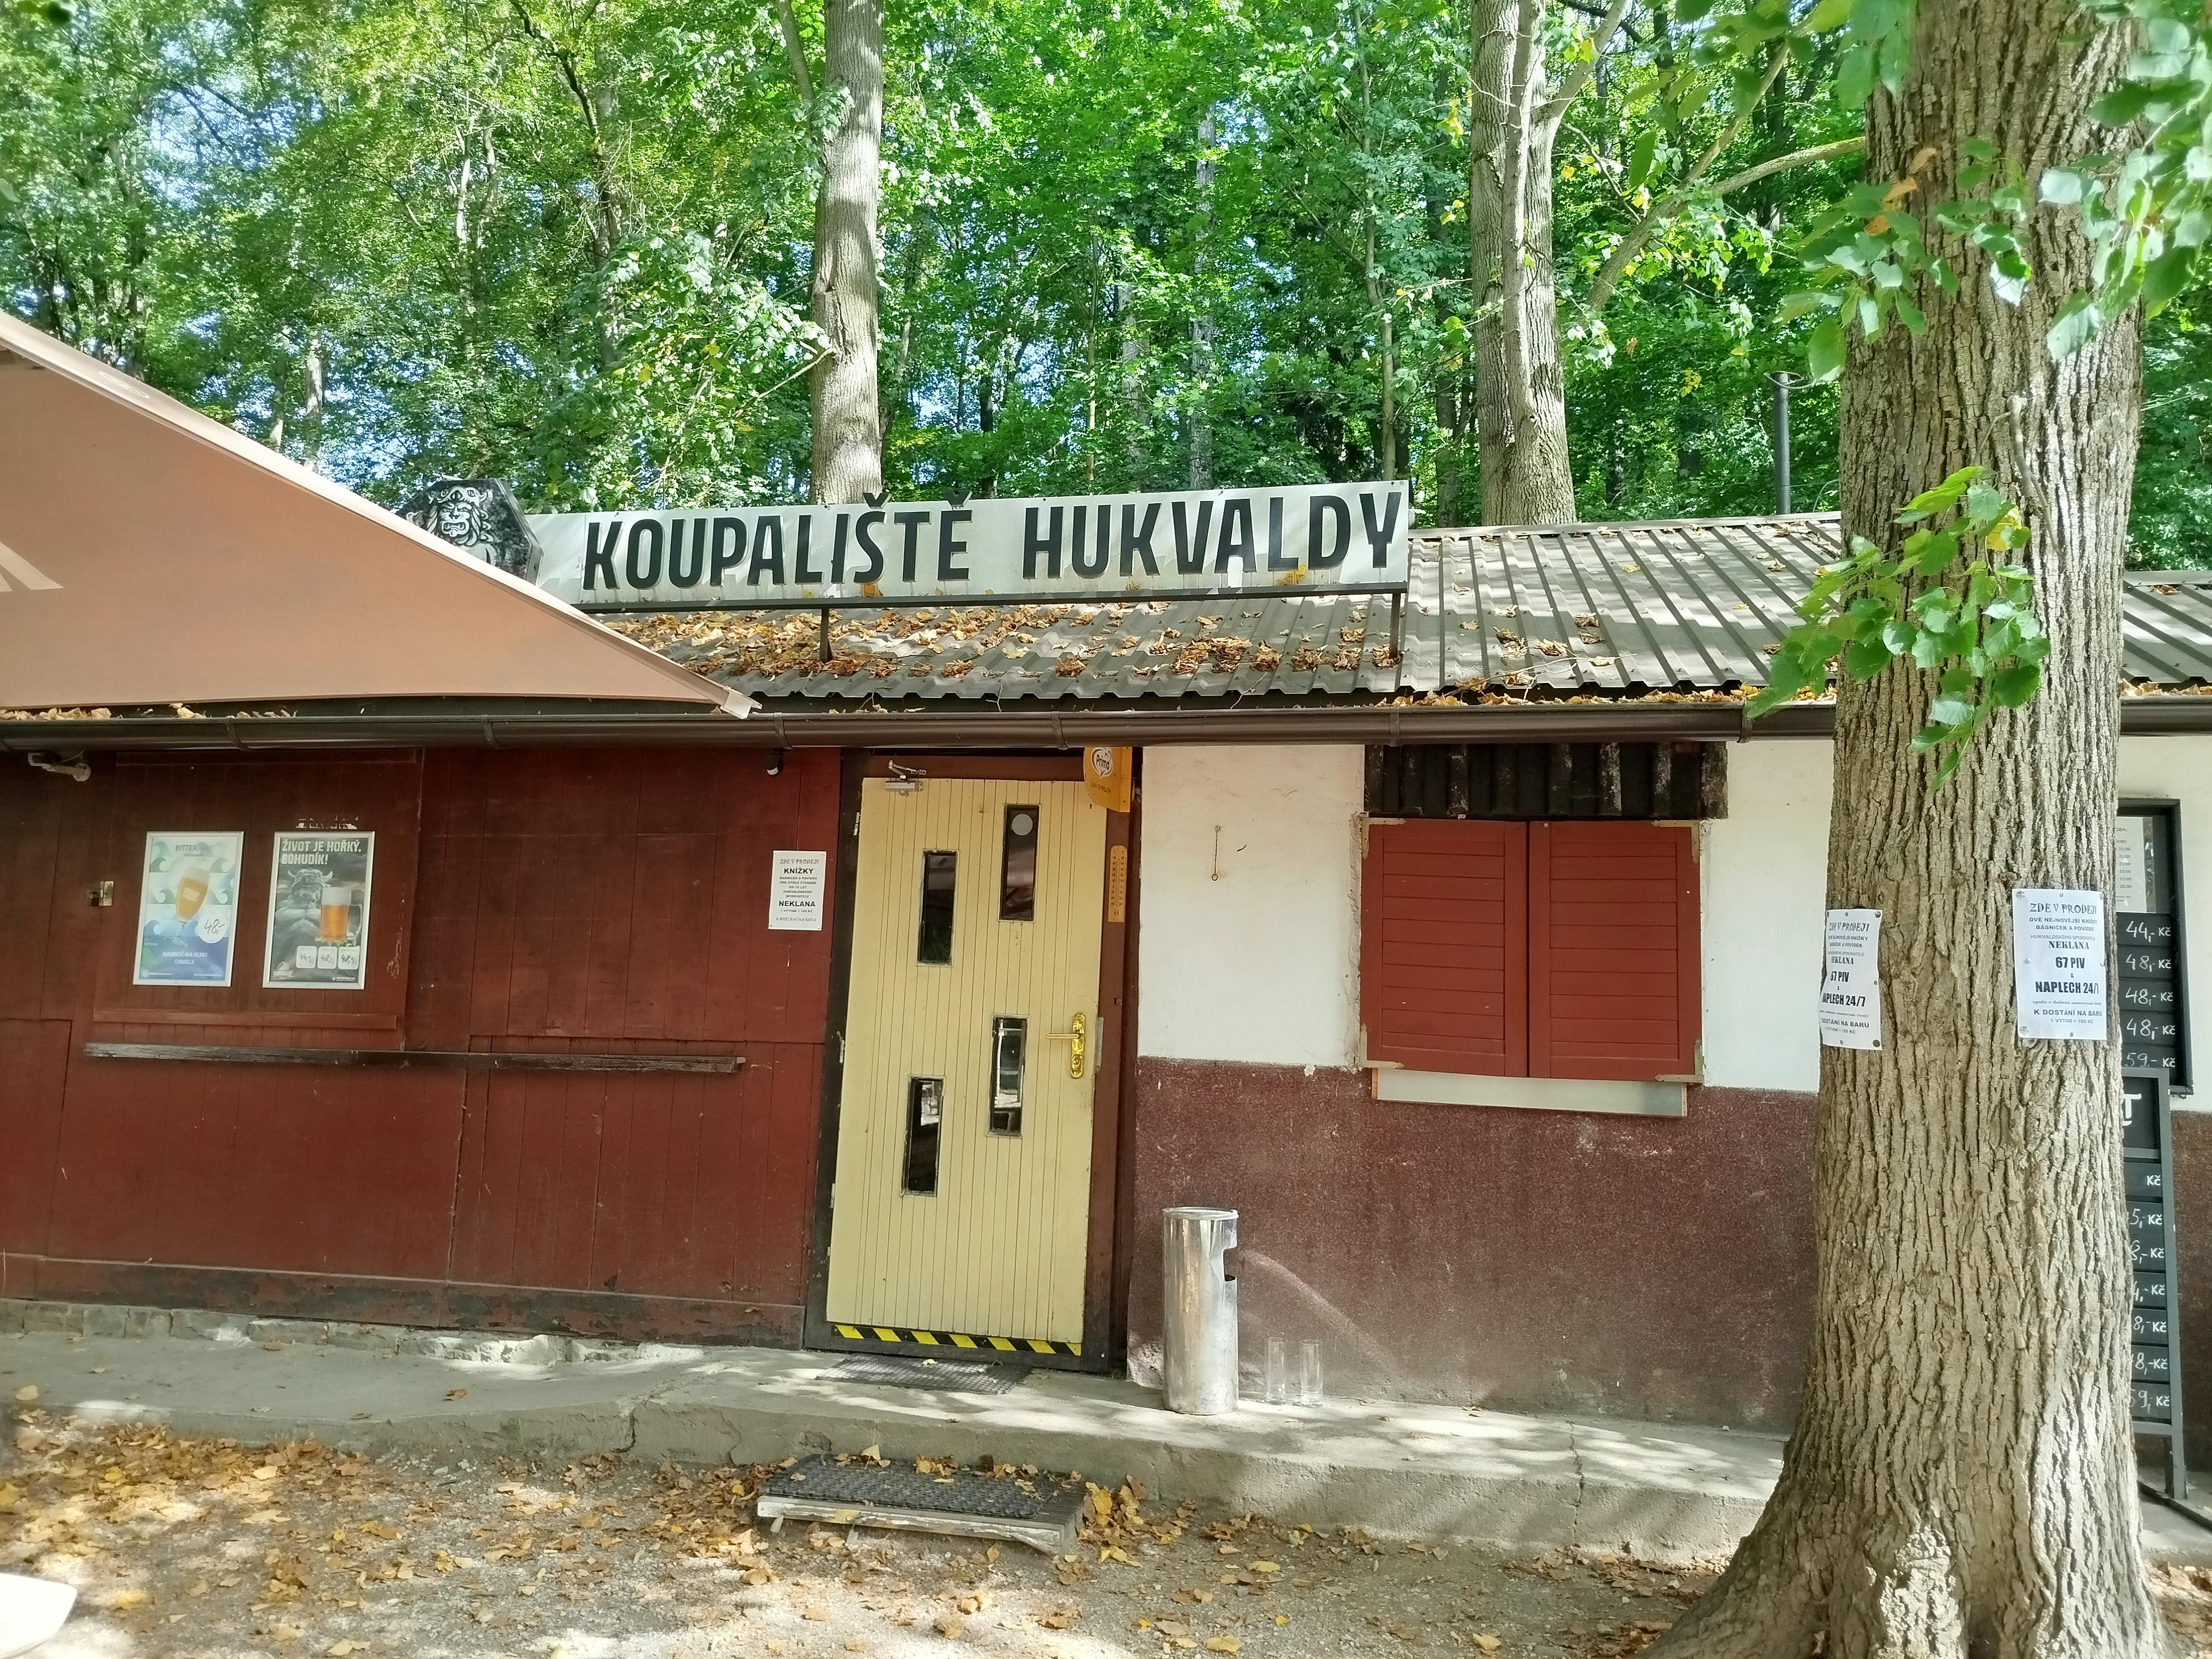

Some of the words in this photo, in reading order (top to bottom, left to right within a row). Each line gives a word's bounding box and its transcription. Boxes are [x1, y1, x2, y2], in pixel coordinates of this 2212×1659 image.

[583, 493, 973, 590] KOUPALIŠTĚ
[1022, 492, 1402, 579] HUKVALDY
[1096, 754, 1109, 770] Prima
[282, 839, 311, 852] ŽIVOT
[313, 841, 324, 852] JE
[326, 839, 362, 852] HOŘKÝ.
[281, 852, 328, 865] BOHUDÍK!
[2030, 903, 2051, 912] ZDE
[2053, 903, 2059, 912] V
[2061, 904, 2096, 915] PRODEJI
[205, 919, 225, 935] 48,-
[1842, 922, 1870, 932] PRODEJI
[2126, 921, 2155, 943] 44,-
[2158, 926, 2171, 936] Kč
[2048, 941, 2089, 950] NEKLANA
[2056, 957, 2068, 968] 67
[2070, 957, 2085, 968] PIV
[2125, 954, 2155, 972] 48,-
[2158, 959, 2171, 969] Kč
[1838, 971, 1849, 982] PIV
[2035, 981, 2081, 993] NAPLECH
[1822, 993, 1844, 1005] APLECH
[1846, 995, 1865, 1007] 24/7
[2125, 987, 2156, 1006] 48,-
[2160, 992, 2173, 1001] Kč
[2126, 1018, 2158, 1040] 48,-
[2162, 1025, 2176, 1035] Kč
[2162, 1057, 2176, 1067] Kč
[2147, 1175, 2161, 1186] Kč
[2127, 1208, 2146, 1229] 5,-
[2148, 1214, 2163, 1225] Kč
[2130, 1240, 2148, 1264] 8,-
[2150, 1248, 2164, 1258] Kč
[2151, 1284, 2166, 1295] Kč
[2133, 1316, 2151, 1333] 8,-
[2152, 1321, 2167, 1332] Kč
[2153, 1358, 2168, 1370] Kč
[2156, 1395, 2170, 1406] Kč
